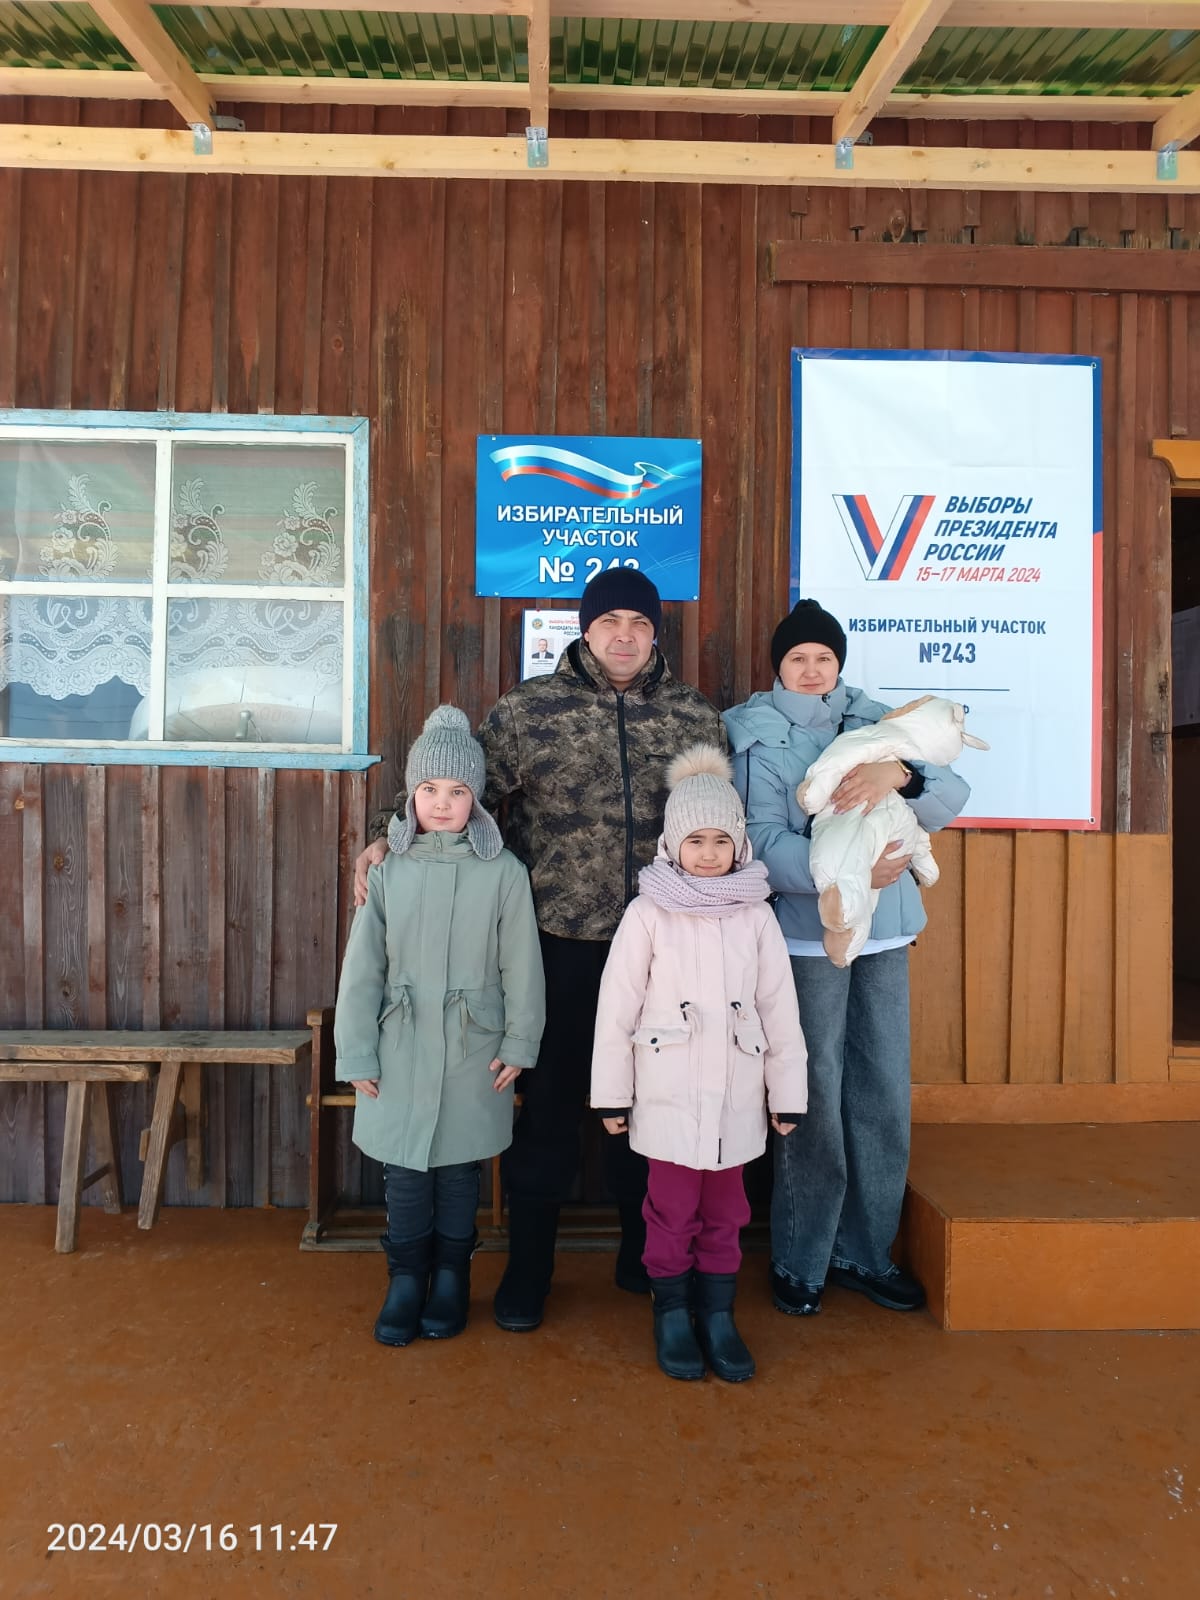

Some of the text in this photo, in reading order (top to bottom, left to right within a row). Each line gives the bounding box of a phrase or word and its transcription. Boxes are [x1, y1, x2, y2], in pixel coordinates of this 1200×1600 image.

[945, 495, 1033, 514] ВЫБОРЫ
[497, 504, 683, 525] ИЗБИРАТЕЛЬНЫЙ
[542, 528, 639, 547] УЧАСТОК
[934, 519, 1058, 540] ПРЕЗИДЕНТА
[923, 543, 1006, 562] РОССИИ
[956, 567, 1005, 582] МАРТА
[1007, 567, 1041, 583] 2024
[849, 617, 1046, 635] ИЗБИРАТЕЛЬНЫЙ УЧАСТОК
[919, 642, 976, 664] №243
